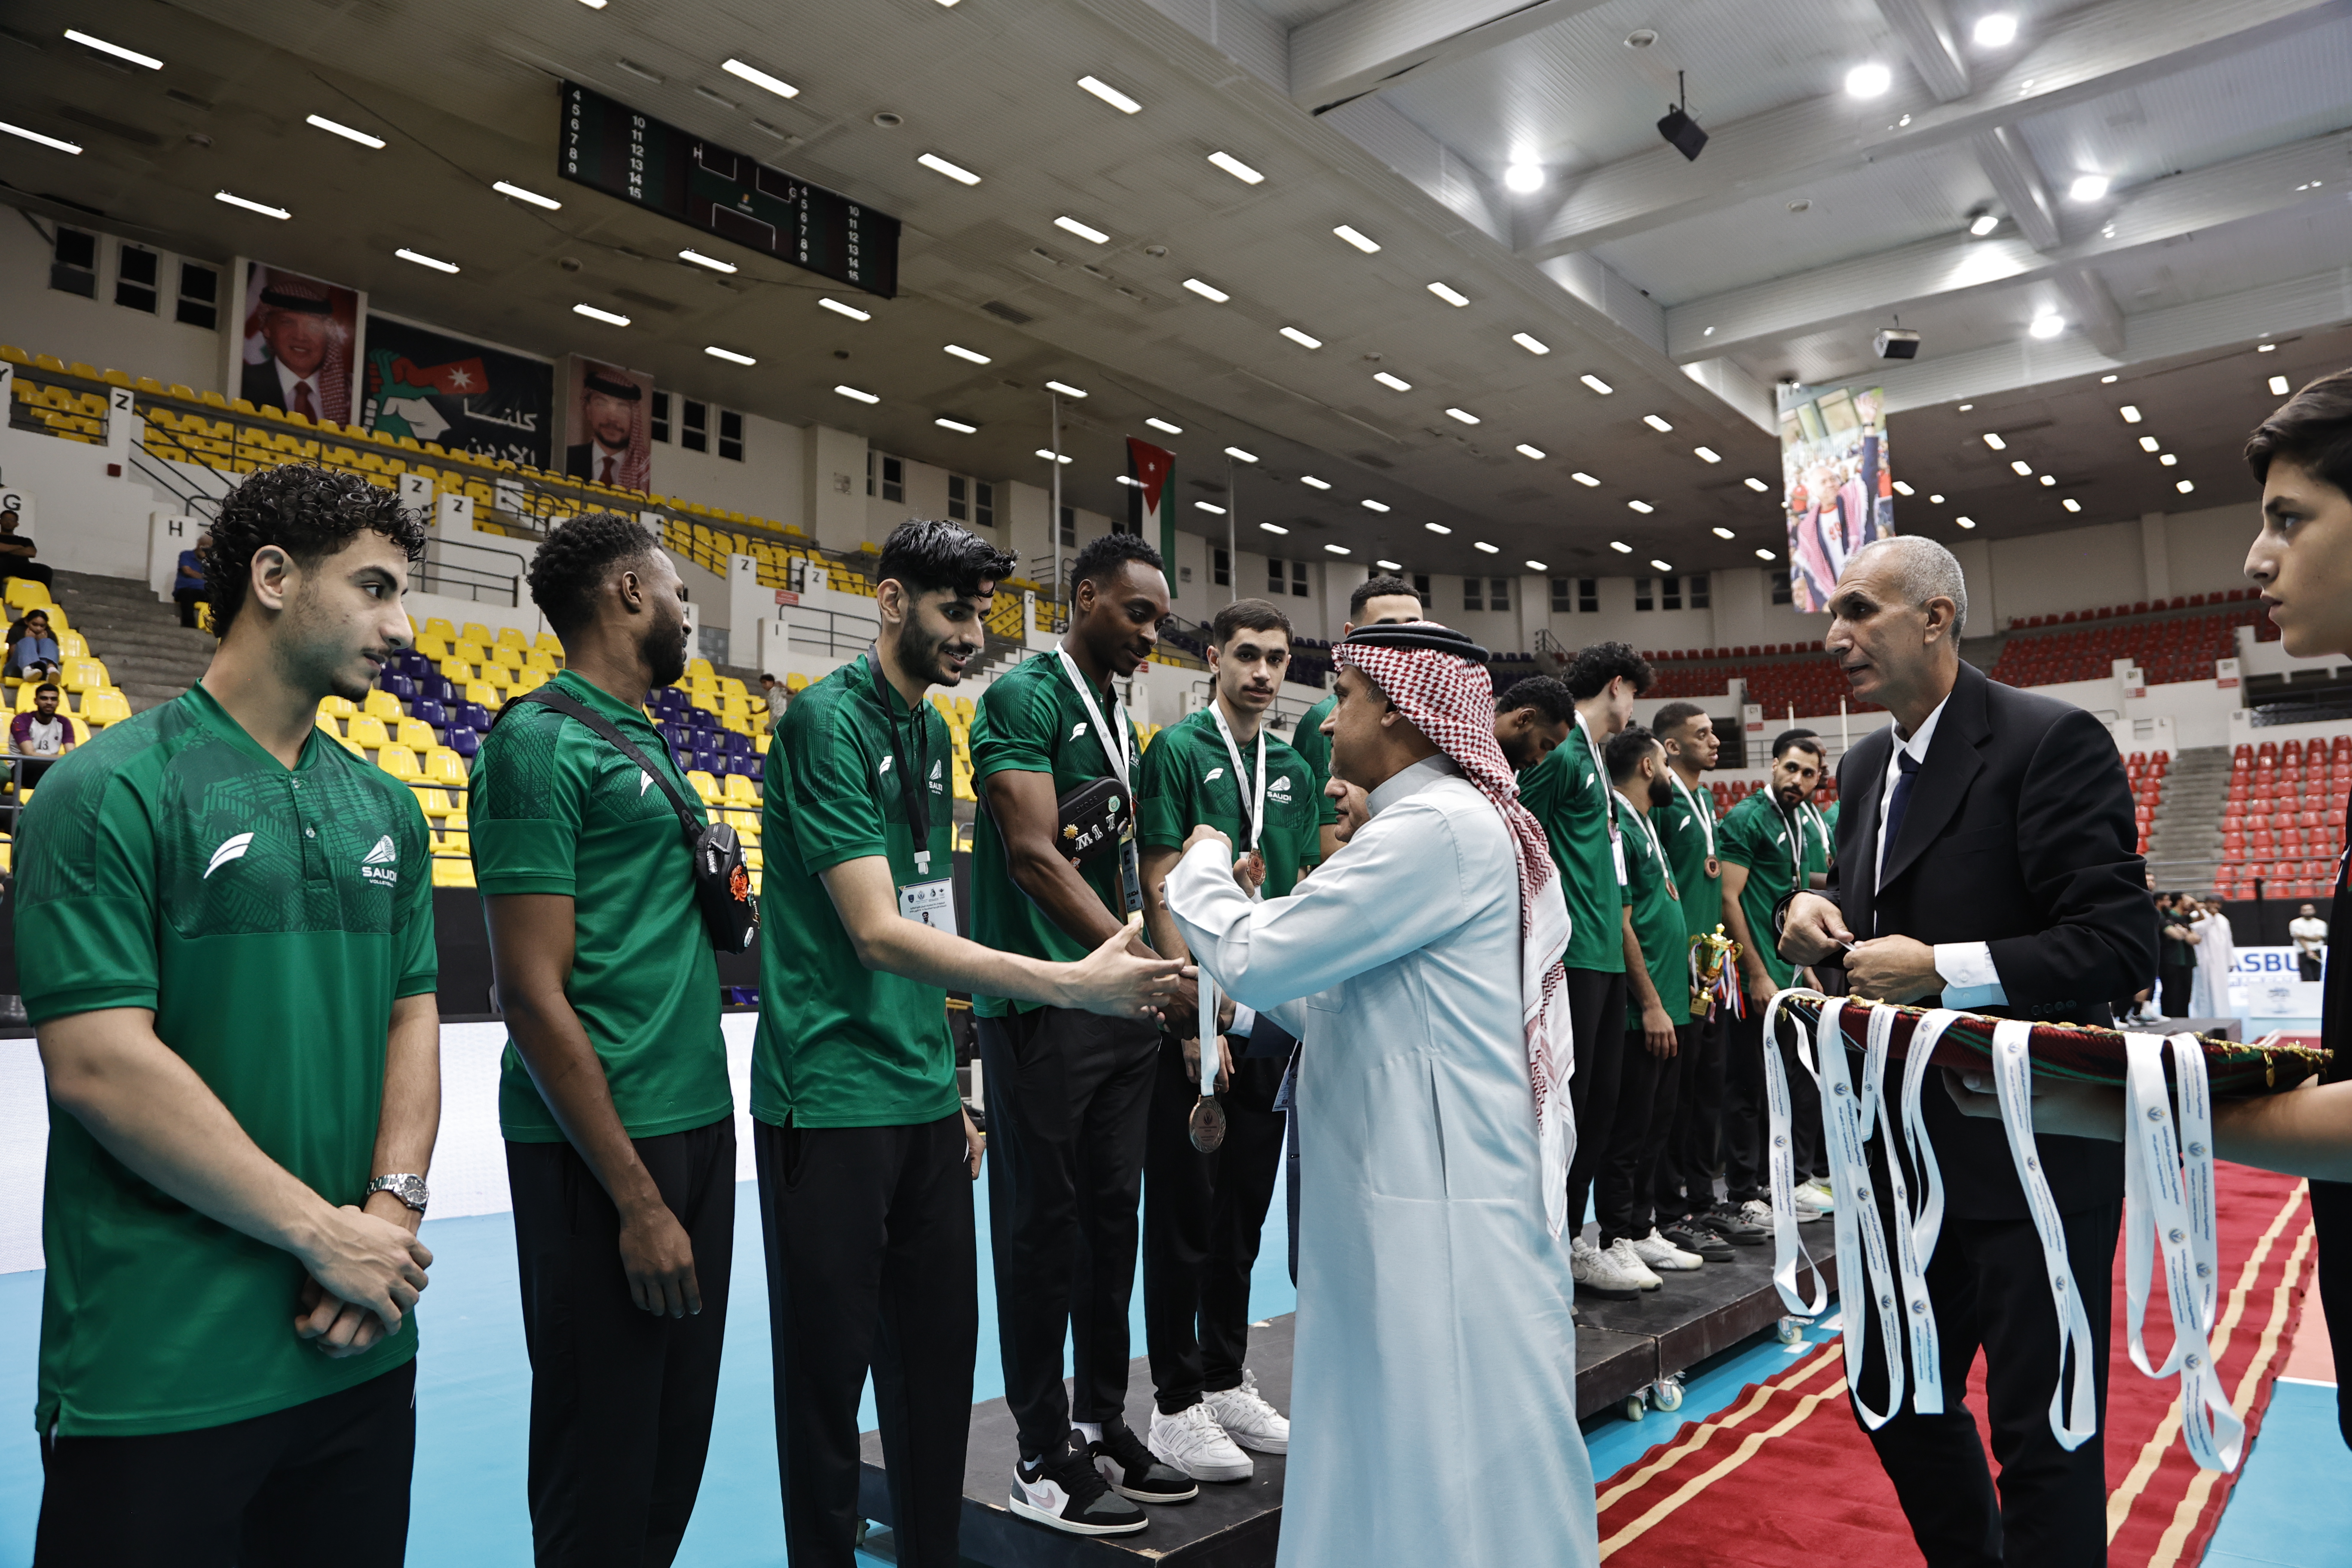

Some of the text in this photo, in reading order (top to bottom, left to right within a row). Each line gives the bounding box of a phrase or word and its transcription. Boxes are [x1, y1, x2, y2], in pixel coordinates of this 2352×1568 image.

[573, 91, 581, 100] 4
[572, 104, 580, 116] 5
[571, 118, 579, 130] 6
[633, 115, 645, 128] 10
[571, 133, 578, 144] 7
[632, 129, 643, 142] 11
[569, 147, 578, 159] 8
[631, 144, 644, 156] 12
[568, 162, 577, 173] 9
[630, 158, 643, 171] 13
[629, 172, 642, 185] 14
[628, 186, 642, 199] 15
[801, 187, 808, 196] 4
[801, 199, 808, 209] 5
[849, 205, 859, 216] 10
[800, 212, 808, 223] 6
[848, 218, 858, 229] 11
[801, 225, 807, 235] 7
[848, 231, 859, 242] 12
[800, 238, 808, 250] 8
[848, 244, 859, 255] 13
[800, 251, 808, 262] 9
[848, 257, 859, 268] 14
[848, 270, 859, 280] 15
[115, 393, 129, 410] Z
[412, 479, 423, 492] Z
[453, 499, 463, 512] Z
[169, 520, 183, 537] H
[741, 559, 750, 570] Z
[812, 570, 821, 582] Z
[1028, 593, 1034, 603] Z
[1267, 791, 1292, 801] SAUDI
[362, 866, 397, 882] SAUDI
